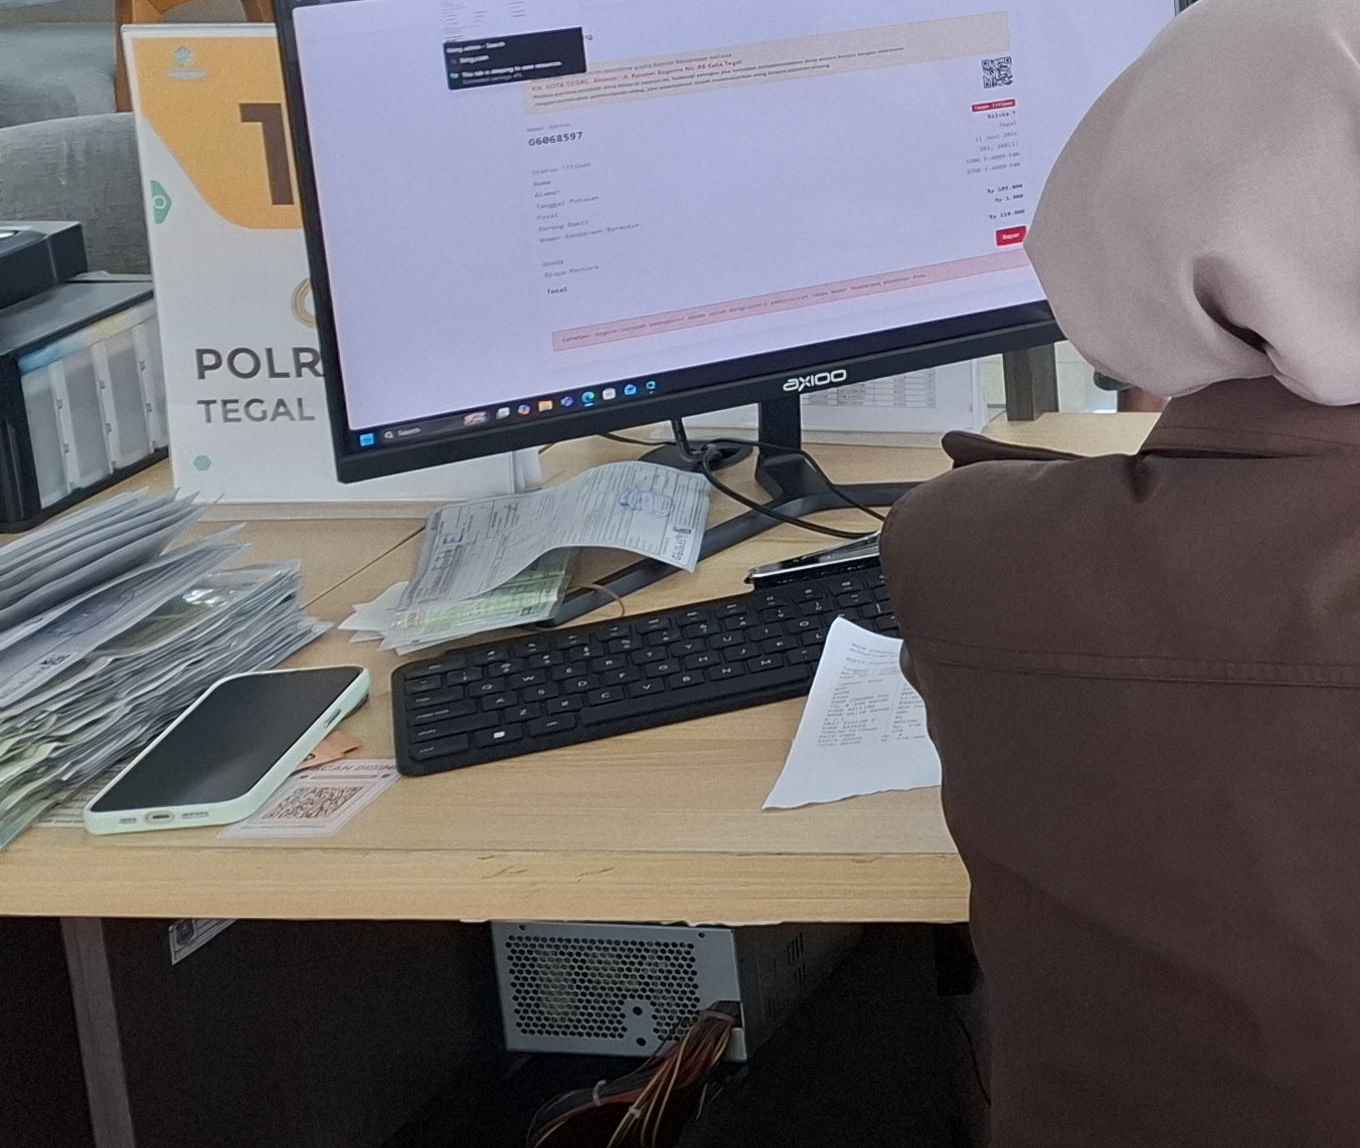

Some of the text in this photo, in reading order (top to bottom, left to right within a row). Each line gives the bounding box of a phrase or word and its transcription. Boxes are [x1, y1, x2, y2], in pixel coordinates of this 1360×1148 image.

[566, 79, 588, 88] TEGAL
[528, 131, 583, 147] G6068597
[194, 346, 325, 381] POLR
[196, 397, 316, 424] TEGAL
[354, 763, 398, 772] DISIN
